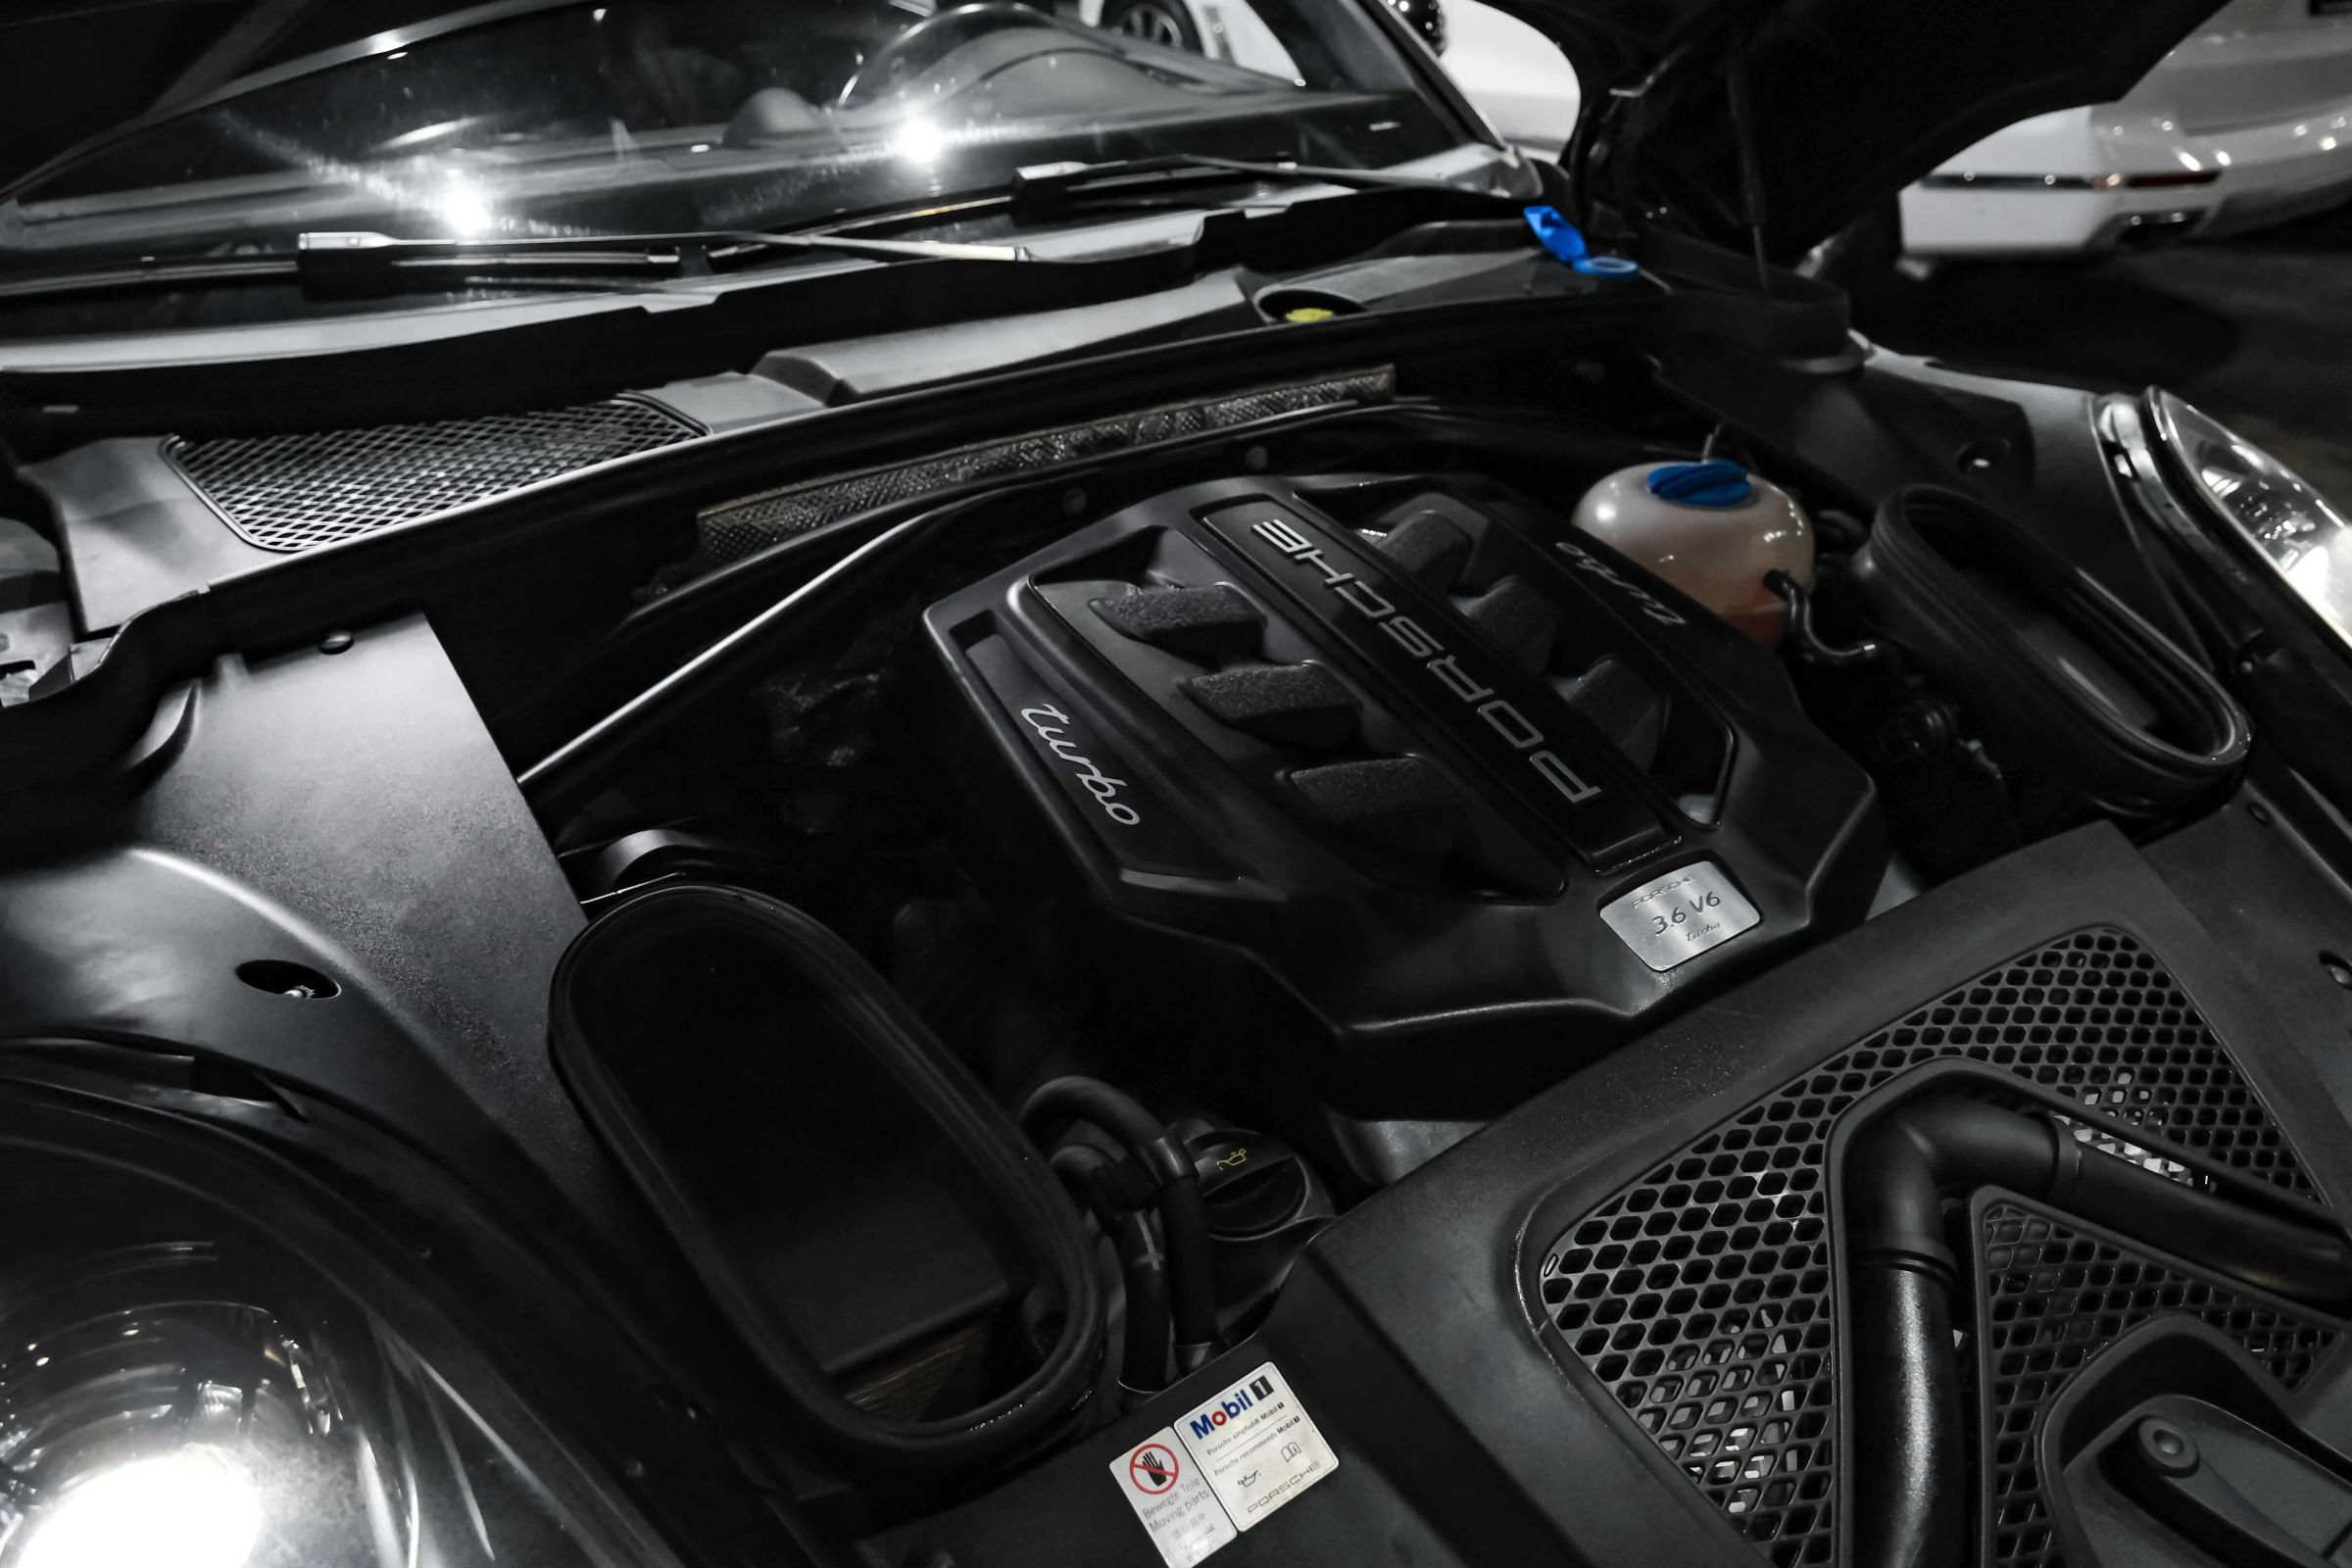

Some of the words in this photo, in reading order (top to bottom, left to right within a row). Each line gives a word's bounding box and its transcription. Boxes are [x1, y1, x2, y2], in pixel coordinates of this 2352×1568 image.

[1251, 519, 1602, 803] PORSCHE
[1021, 703, 1141, 825] turbo
[1632, 874, 1696, 908] PORSCHE
[1652, 907, 1687, 936] 3.6
[1690, 891, 1721, 913] V6
[1686, 923, 1720, 942] turbo
[1190, 1389, 1253, 1440] Mobil
[1207, 1437, 1232, 1455] Porsche
[1260, 1406, 1279, 1420] Mobil
[1214, 1458, 1239, 1476] Porsche
[1240, 1433, 1278, 1460] recommends
[1277, 1420, 1295, 1434] Mobil
[1142, 1491, 1180, 1520] Bewegte
[1180, 1477, 1200, 1494] Teile
[1149, 1506, 1186, 1533] Moving
[1184, 1489, 1210, 1512] parts
[1247, 1460, 1320, 1514] PORSCHE
